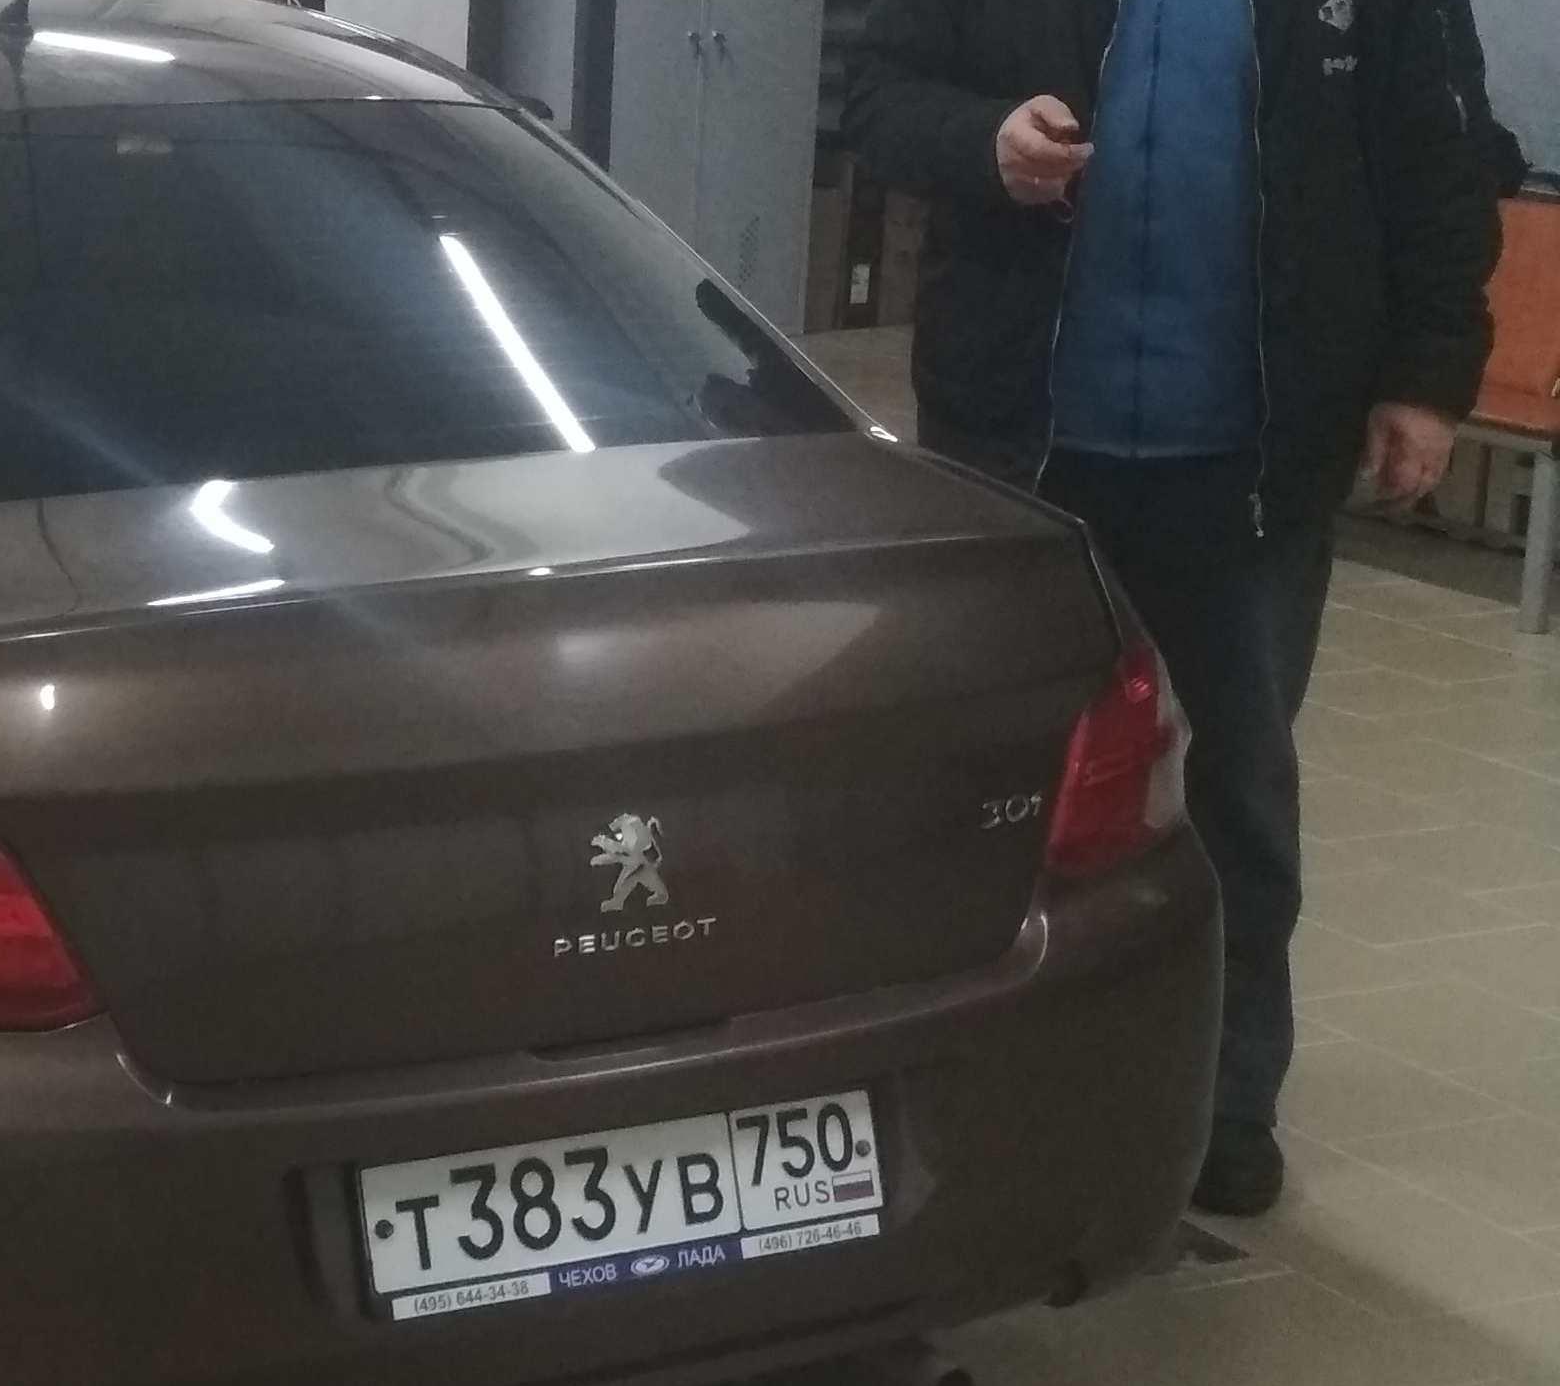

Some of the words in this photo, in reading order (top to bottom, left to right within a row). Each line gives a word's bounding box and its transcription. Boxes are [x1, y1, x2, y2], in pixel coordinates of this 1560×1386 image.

[553, 917, 717, 957] PEUGEOT
[736, 1102, 854, 1188] 750
[774, 1181, 830, 1211] RUS
[559, 1262, 617, 1288] ЧЕХОВ
[677, 1244, 726, 1269] ЛАДА
[414, 1293, 452, 1314] (495)
[456, 1280, 530, 1307] 644-34-38
